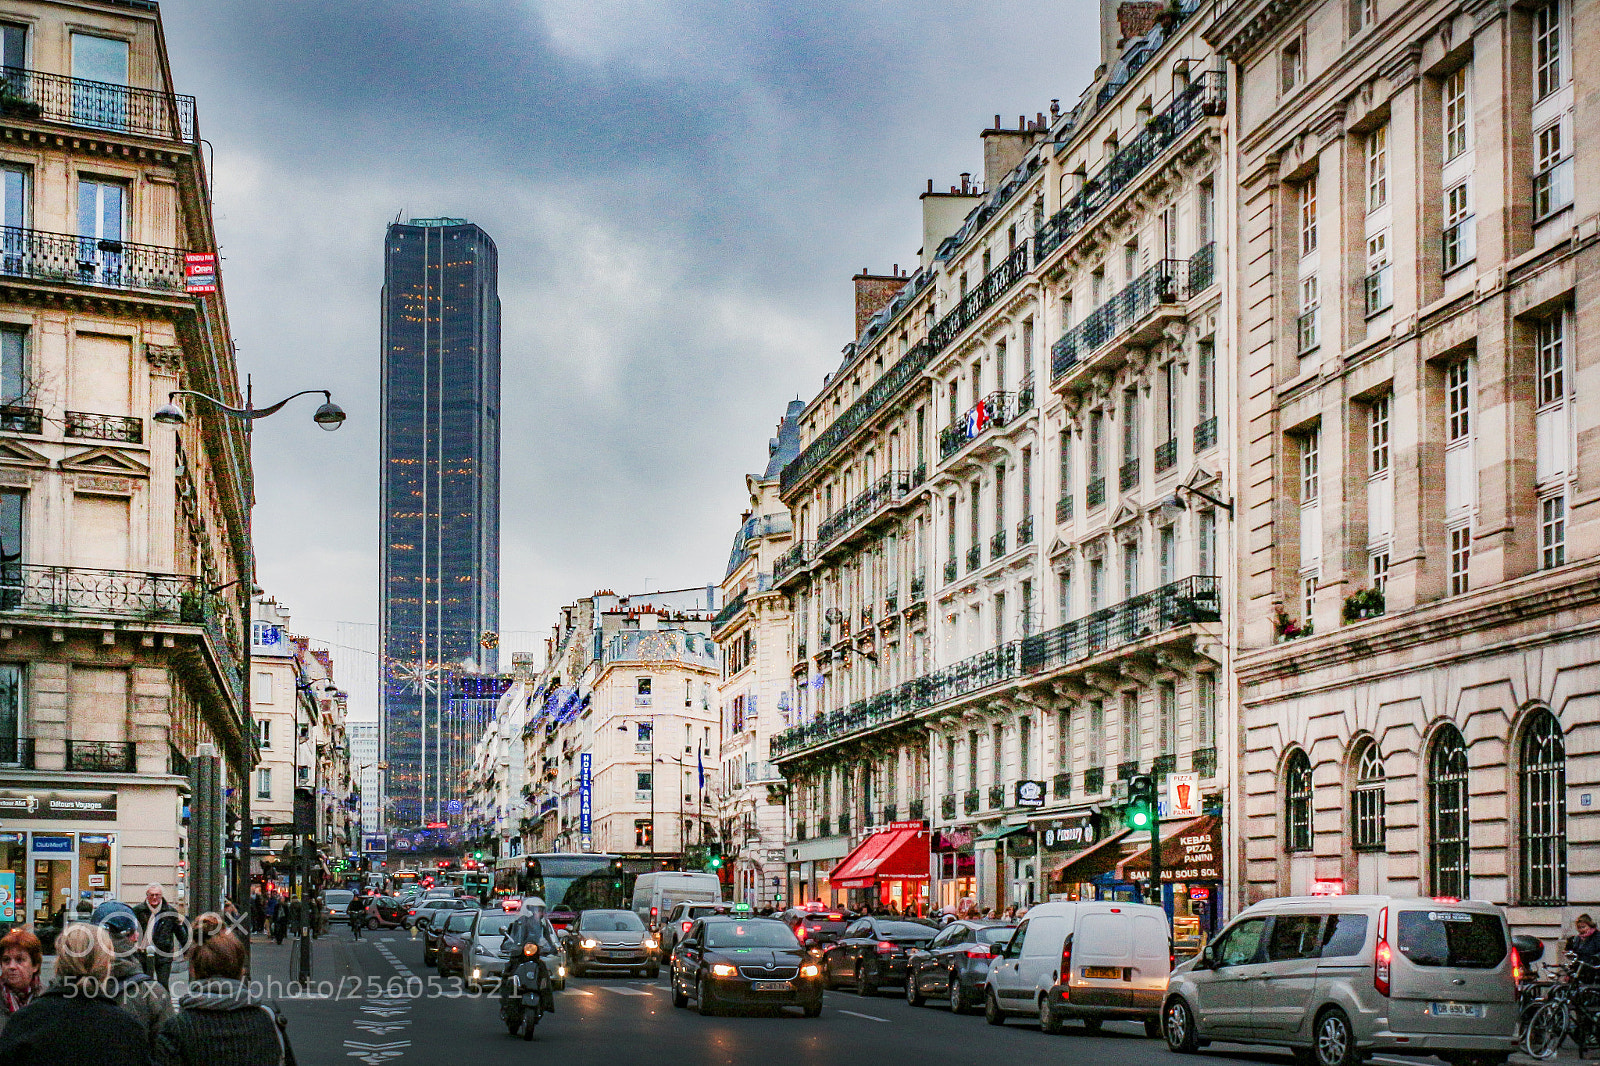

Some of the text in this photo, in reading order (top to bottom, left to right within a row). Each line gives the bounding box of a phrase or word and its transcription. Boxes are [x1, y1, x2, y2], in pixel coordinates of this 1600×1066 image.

[195, 265, 213, 273] ORPI
[49, 800, 102, 809] Détours Voyages
[582, 789, 590, 827] ARAMIS
[1180, 834, 1212, 846] KEBAB
[1186, 844, 1212, 854] PIZZA
[1184, 853, 1213, 863] PANINI
[1160, 870, 1172, 879] AU
[1175, 869, 1199, 878] SOUS
[1201, 868, 1218, 877] SOL
